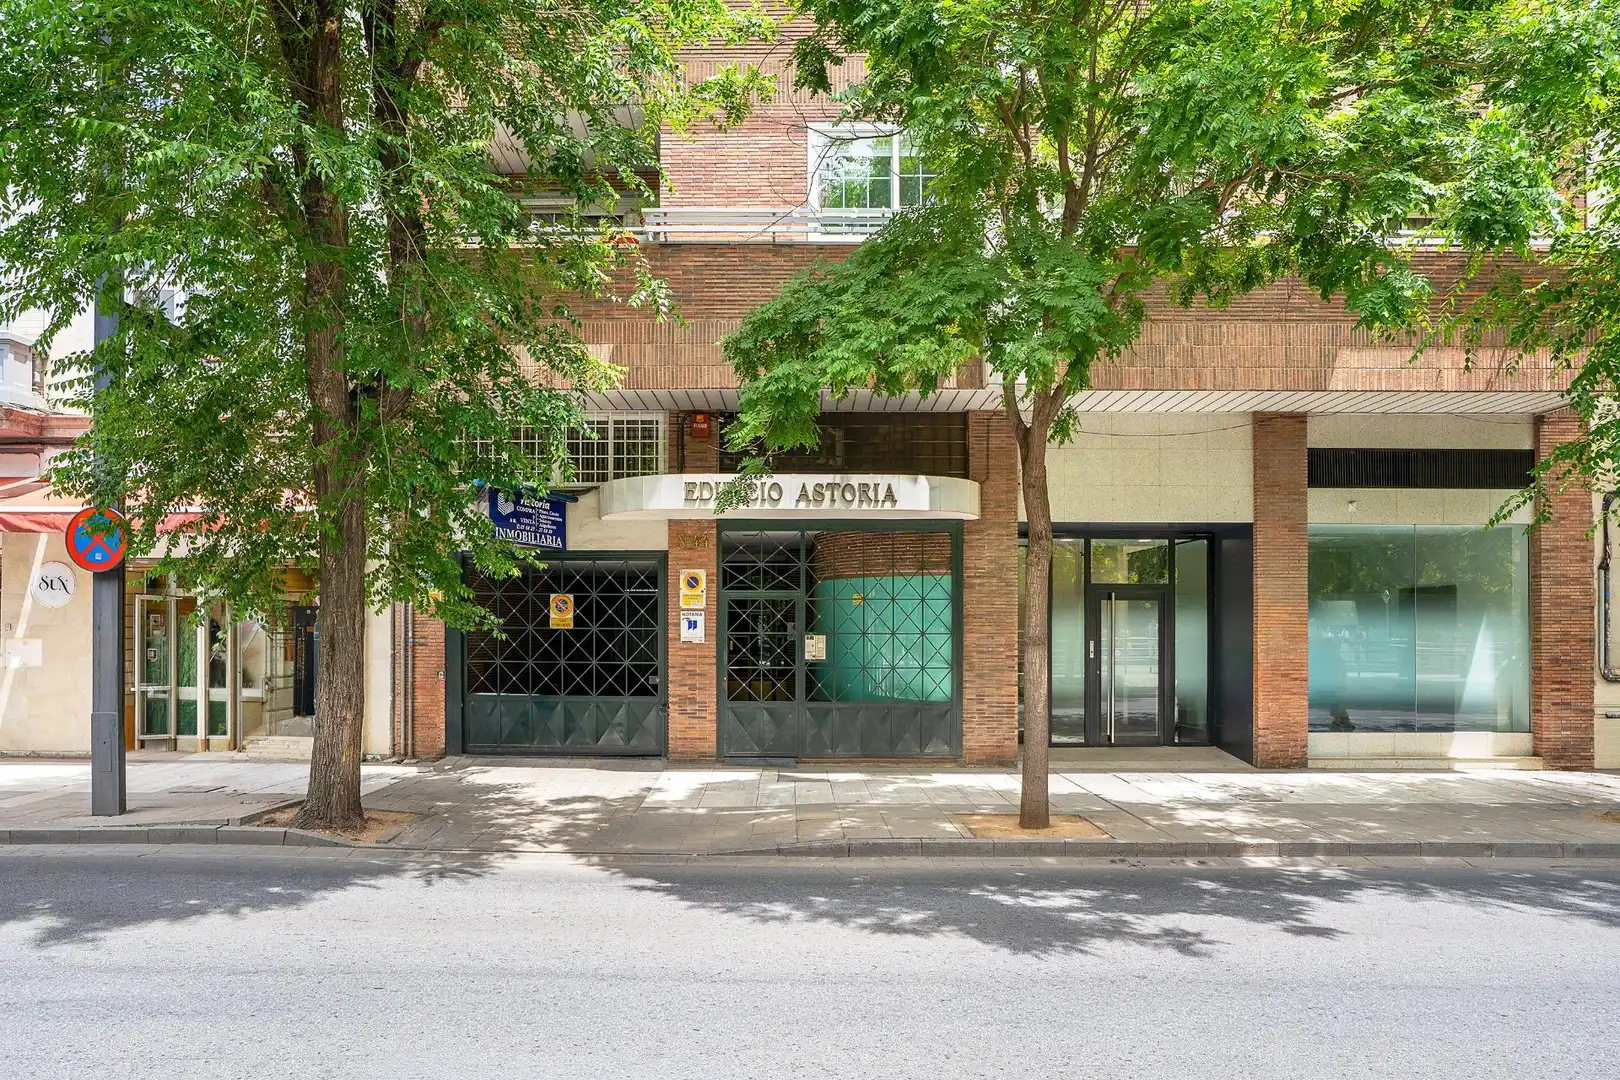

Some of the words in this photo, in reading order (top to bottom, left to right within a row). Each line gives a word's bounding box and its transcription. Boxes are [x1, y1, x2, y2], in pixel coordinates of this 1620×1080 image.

[684, 481, 783, 501] EDICIO
[796, 481, 898, 502] ASTORIA
[495, 526, 562, 546] INMOBILIARIA
